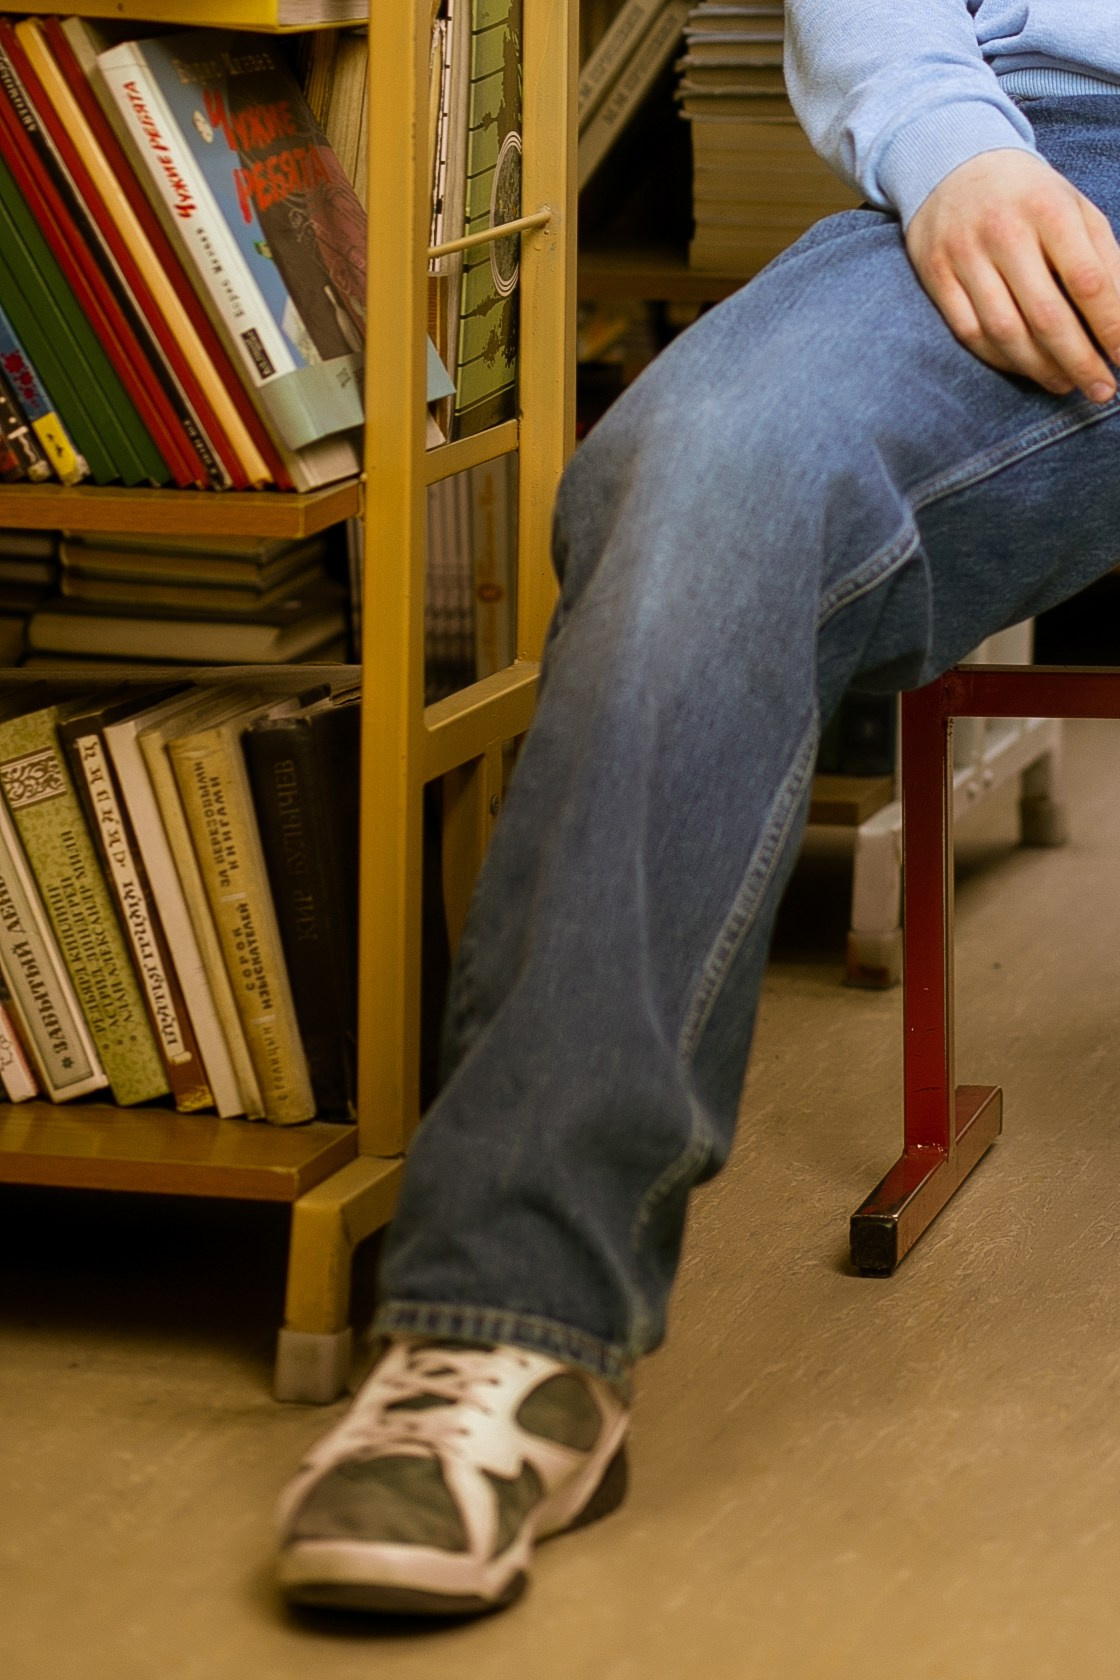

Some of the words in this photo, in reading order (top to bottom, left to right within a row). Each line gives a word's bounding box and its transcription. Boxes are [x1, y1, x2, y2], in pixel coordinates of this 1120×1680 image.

[232, 142, 331, 225] РЕБЯТА
[205, 774, 243, 870] КНИГАМИ
[270, 758, 311, 875] БУЛЫЧЕВ
[59, 829, 88, 880] МИЛН
[217, 867, 232, 887] ЗА
[45, 882, 85, 963] КИПЛИНГ
[57, 875, 101, 963] ЛИНДГРЕН
[76, 882, 123, 978] АЛЕКСАНДР
[289, 887, 320, 942] КИР
[230, 925, 257, 991] СОРОК
[234, 900, 276, 1010] ИЗЫСКАТЕЛЕЙ
[10, 938, 70, 1056] ЗАБЫТЫЙ
[75, 965, 109, 1033] РЕДЬЯРД
[90, 967, 122, 1029] АСТРИД
[110, 980, 136, 1024] АЛАН
[257, 1024, 289, 1090] ГОЛИЦЫН
